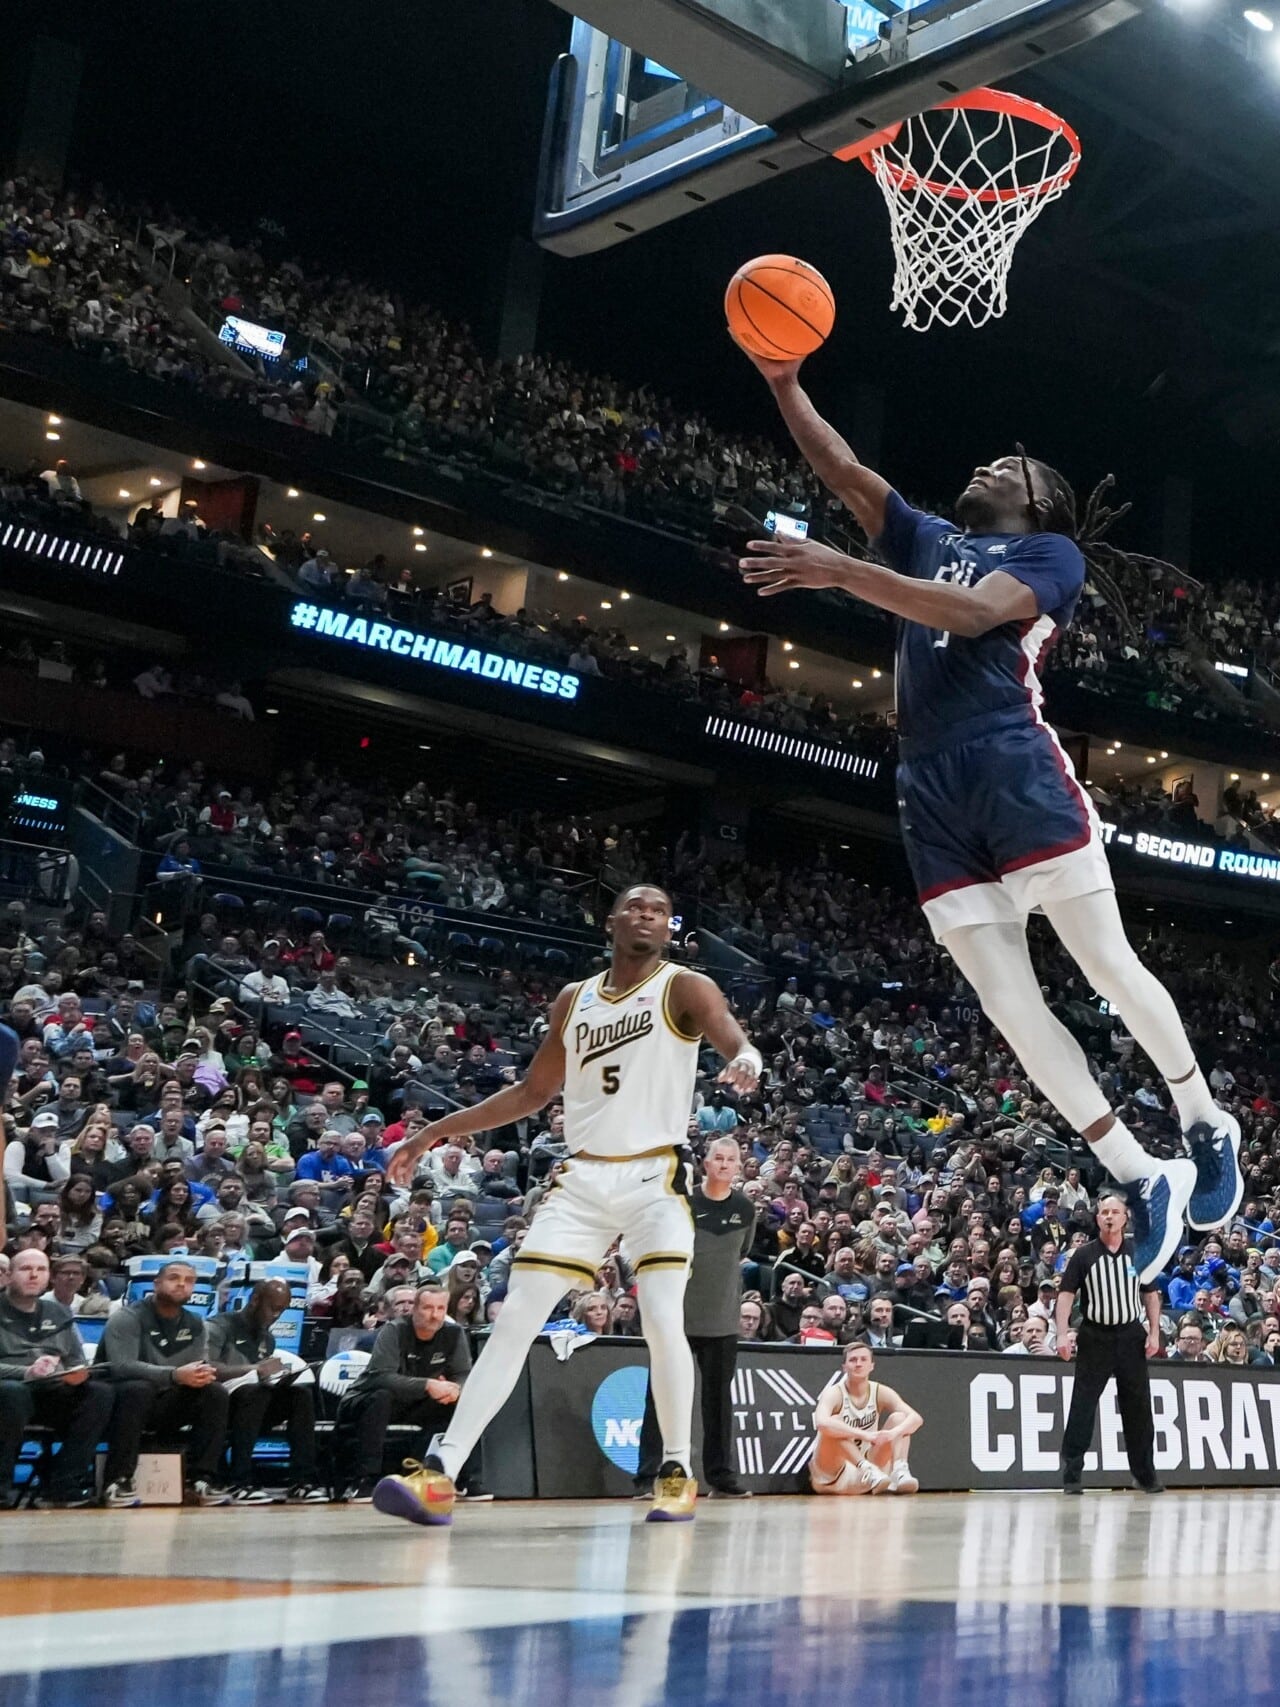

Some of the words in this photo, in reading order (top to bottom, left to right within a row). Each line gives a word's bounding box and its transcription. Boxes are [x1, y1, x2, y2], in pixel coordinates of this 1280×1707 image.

[291, 603, 580, 699] #MARCHMADNESS
[17, 794, 59, 810] NESS
[1135, 832, 1215, 867] SECOND
[397, 903, 435, 926] 104
[955, 1005, 980, 1024] 105
[575, 1010, 655, 1055] Purdue
[601, 1064, 621, 1095] 5
[603, 1418, 644, 1448] NC
[734, 1411, 818, 1431] TITL
